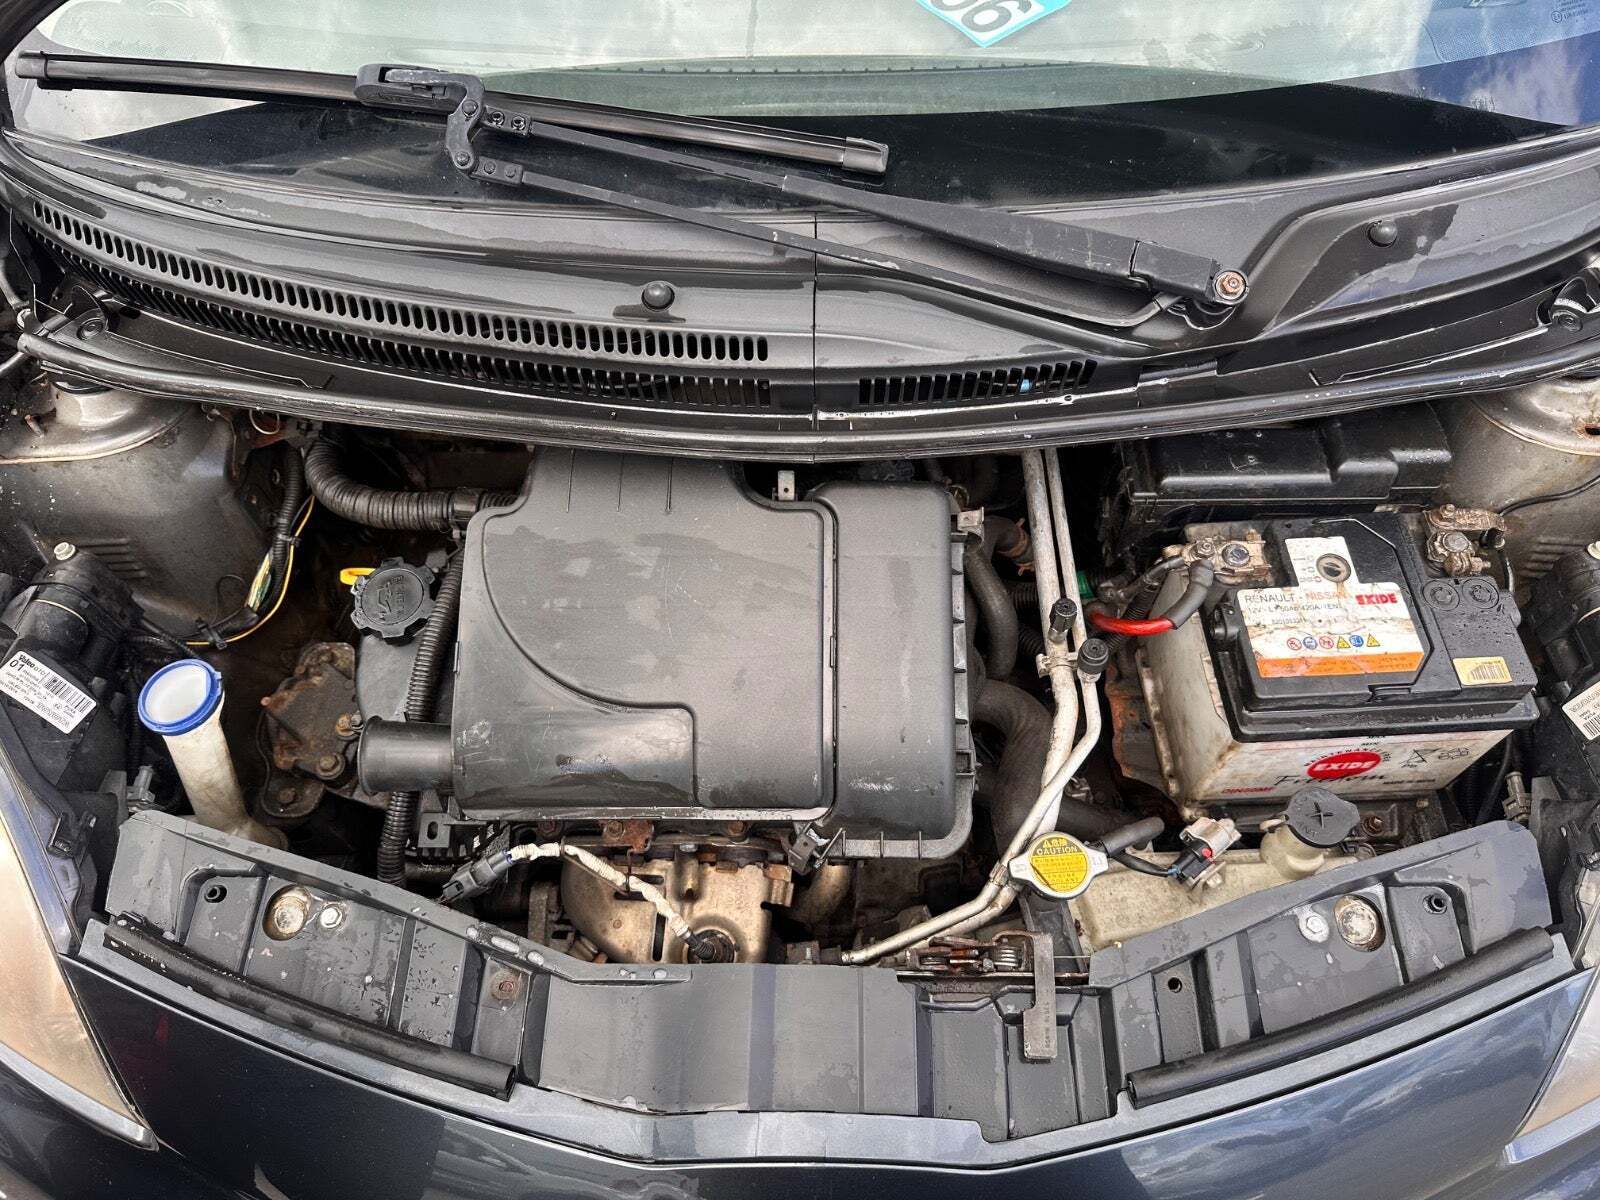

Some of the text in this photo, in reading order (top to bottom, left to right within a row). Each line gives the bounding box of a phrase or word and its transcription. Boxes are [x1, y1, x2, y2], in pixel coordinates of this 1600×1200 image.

[1245, 592, 1295, 603] RENAULT
[1355, 592, 1398, 605] EXIDE
[9, 659, 25, 671] 01
[18, 654, 36, 668] Valeo
[1313, 761, 1377, 771] EXIDE
[1036, 846, 1078, 855] CAUTION
